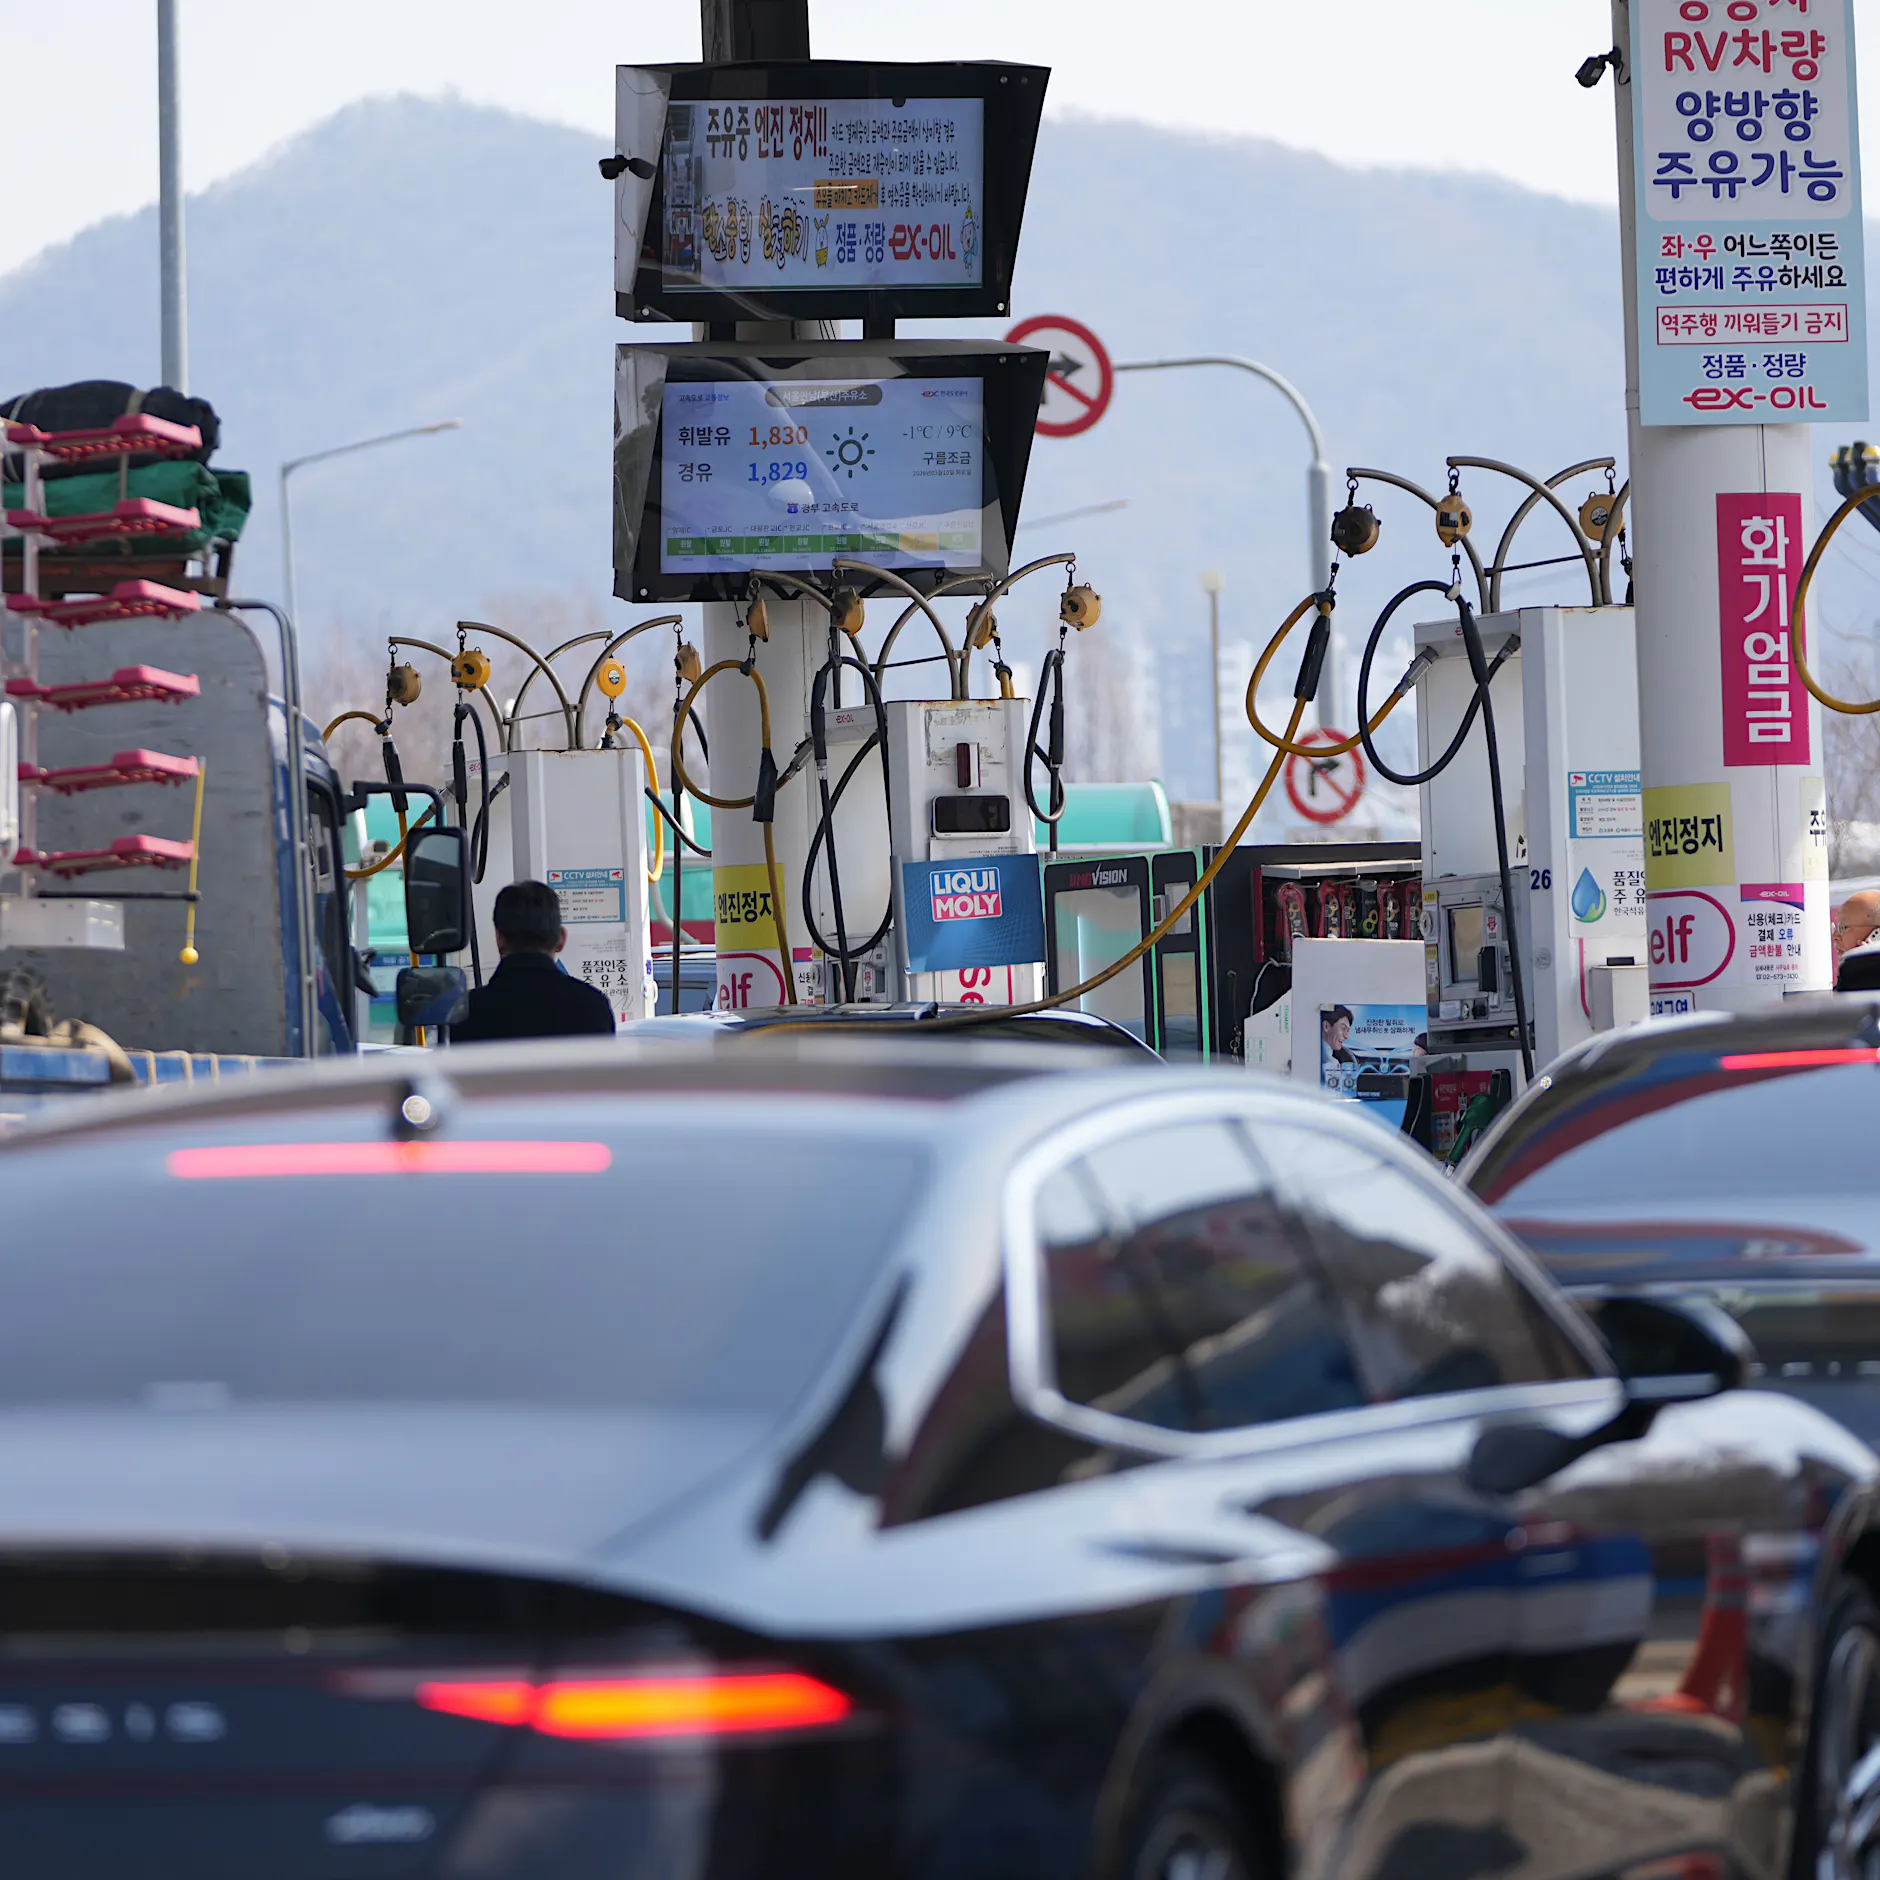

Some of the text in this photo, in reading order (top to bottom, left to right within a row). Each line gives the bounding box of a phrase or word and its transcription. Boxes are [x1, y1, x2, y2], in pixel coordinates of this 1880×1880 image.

[1663, 28, 1827, 82] RV차량
[1675, 88, 1819, 142] 양방향
[706, 105, 827, 161] 주유중 엔진 정지!!
[1652, 149, 1844, 202] 주유가능
[702, 199, 810, 270] 탄소중립 실천하기
[1723, 233, 1839, 261] 어느쪽이든
[1654, 265, 1848, 294] 편하게 주유하세요
[1661, 311, 1842, 337] 역주행 끼워들기 금지
[678, 426, 731, 446] 휘발유
[748, 425, 808, 450] 1,830
[922, 451, 972, 466] 구름조금
[678, 462, 713, 483] 경유
[748, 461, 808, 486] 1,829
[801, 503, 820, 514] 경부
[822, 502, 859, 513] 고속도로
[1740, 514, 1792, 744] 화기엄금
[1588, 772, 1641, 783] CCTV 설치안내
[1649, 814, 1724, 857] 엔진정지
[564, 872, 584, 880] CCTV
[933, 870, 996, 895] LIQUI
[1530, 869, 1552, 891] 26
[935, 893, 999, 919] MOLY
[1747, 912, 1801, 926] 신용(체크)카드
[1758, 928, 1794, 942] 결제 오류
[1749, 944, 1801, 958] 금액환불 안내
[581, 959, 628, 974] 품질인증
